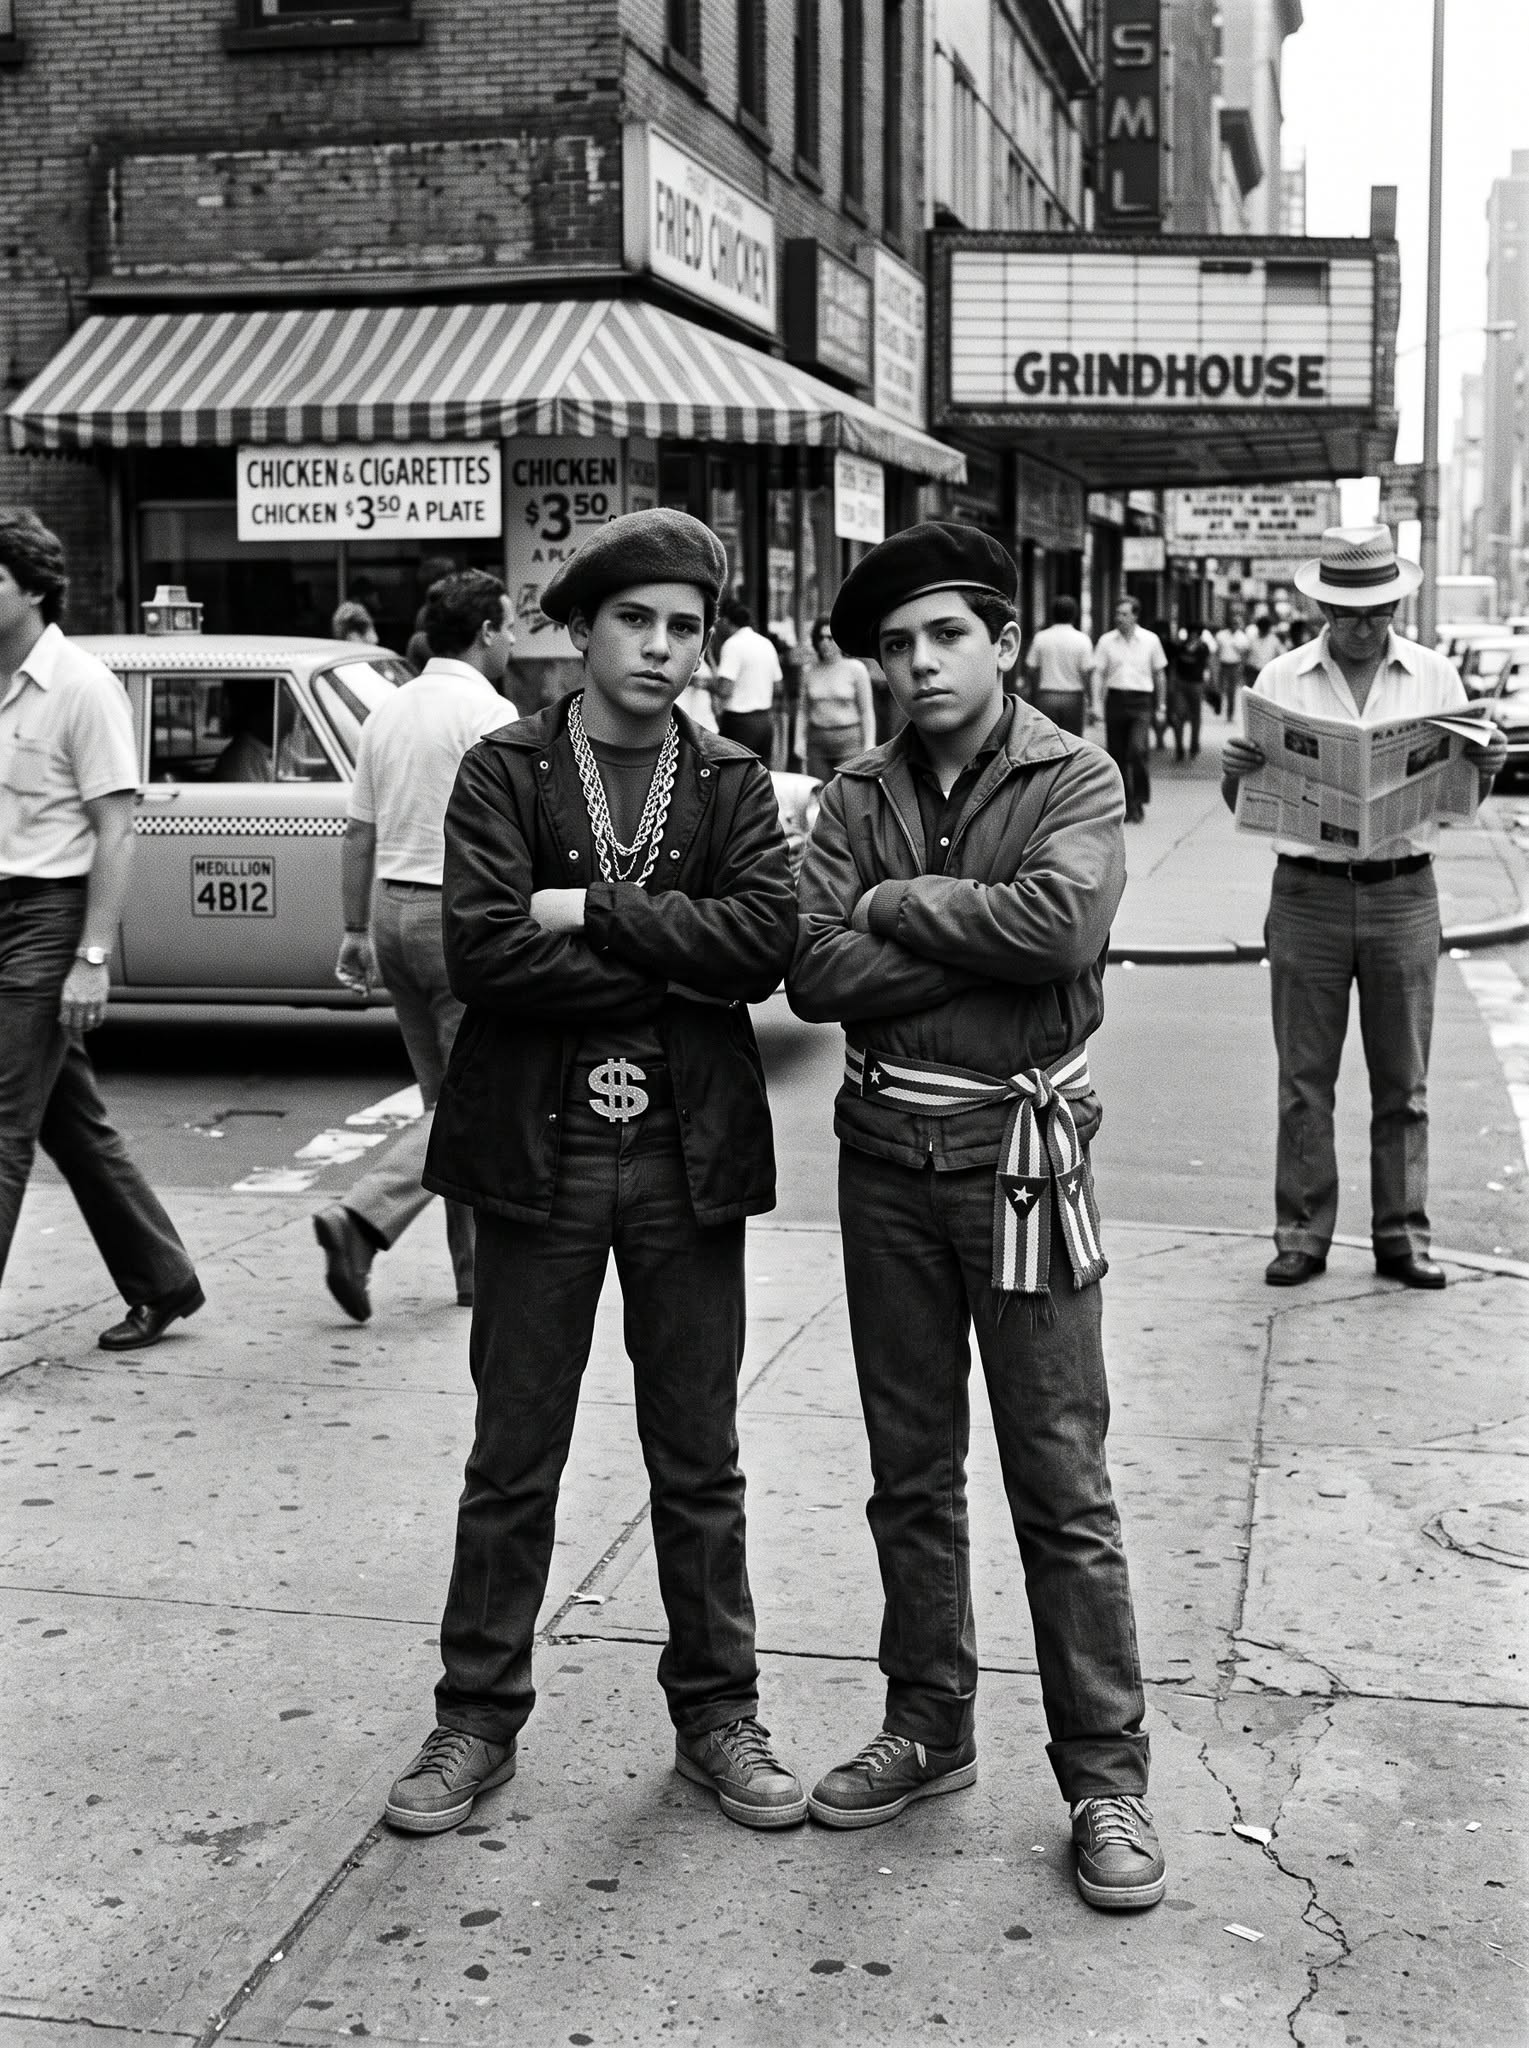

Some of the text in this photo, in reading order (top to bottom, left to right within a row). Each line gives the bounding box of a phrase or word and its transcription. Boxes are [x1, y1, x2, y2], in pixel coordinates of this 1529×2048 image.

[656, 179, 703, 271] FRIED
[709, 213, 770, 309] CHICKEN
[1014, 350, 1327, 398] GRINDHOUSE
[247, 455, 491, 489] CHICKEN & CIGARETTES
[512, 457, 617, 488] CHICKEN
[252, 503, 337, 525] CHICKEN
[406, 502, 419, 522] A
[426, 500, 486, 522] PLATE
[531, 548, 544, 562] A
[197, 881, 269, 912] 4B12
[588, 1058, 649, 1122] $
